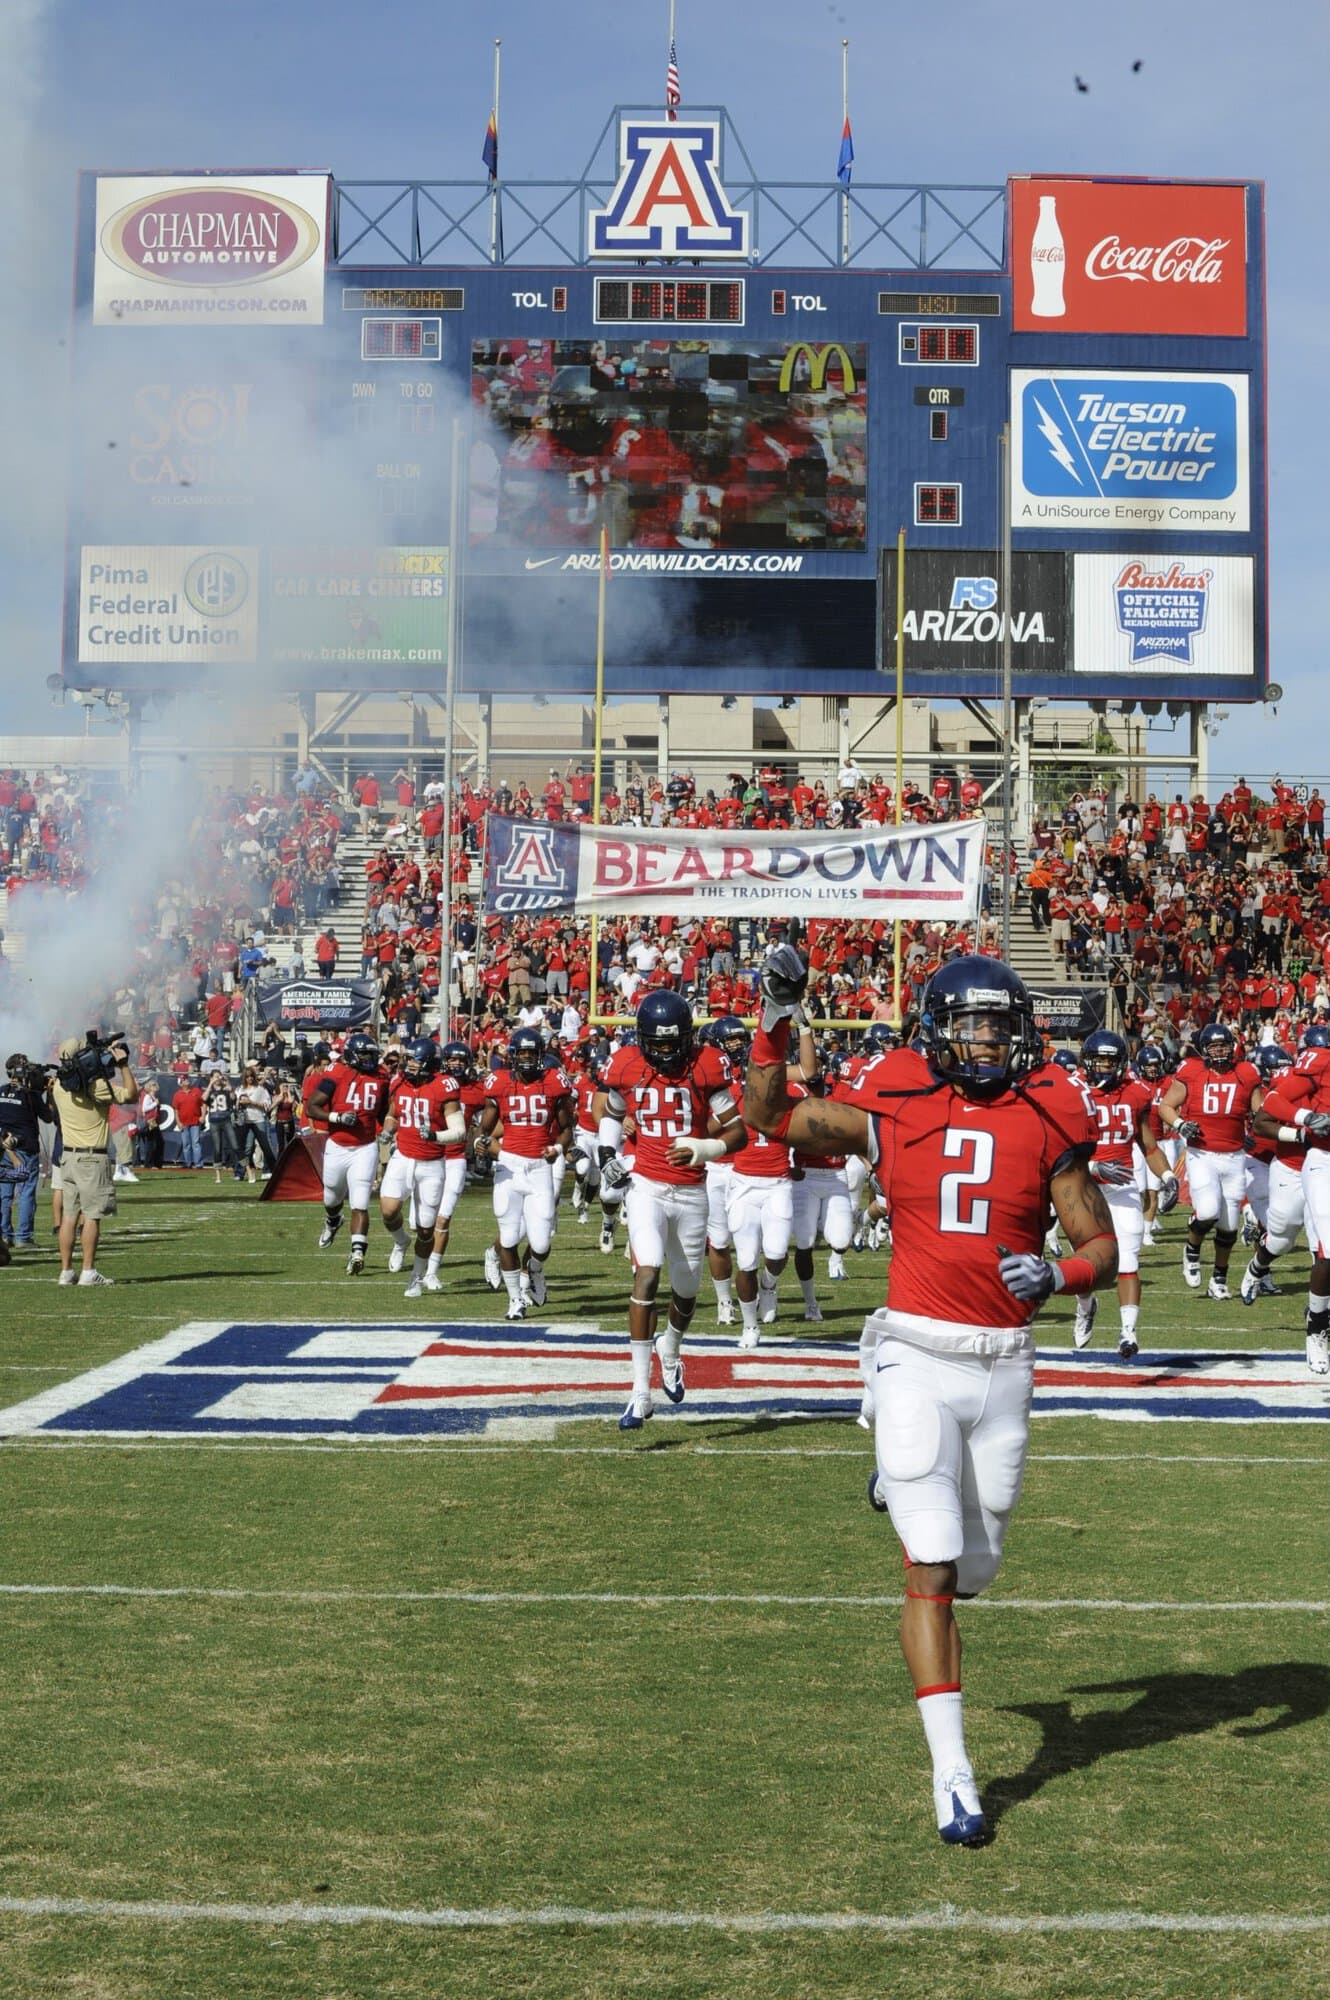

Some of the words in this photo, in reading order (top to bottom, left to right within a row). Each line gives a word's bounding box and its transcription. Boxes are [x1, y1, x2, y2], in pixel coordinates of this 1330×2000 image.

[138, 212, 281, 248] CHAPMAN
[142, 249, 277, 264] AUTOMOTIVE
[1085, 235, 1231, 283] Coca-Cola
[109, 298, 307, 313] CHAPMANTUCSON.COM
[364, 290, 444, 309] ARIZONA
[512, 292, 548, 308] TOL
[791, 295, 826, 311] TOL
[918, 295, 957, 315] WSU
[400, 383, 413, 397] TO
[417, 383, 433, 397] GO
[929, 388, 950, 404] QTR
[1078, 393, 1187, 424] Tucson
[1088, 424, 1216, 453] Electric
[1101, 453, 1216, 481] Power
[920, 488, 957, 519] 25
[1022, 505, 1033, 517] A
[1037, 505, 1111, 518] UniSource
[1115, 506, 1165, 522] Energy
[1169, 507, 1236, 524] Company
[89, 564, 148, 585] Pima
[1117, 564, 1210, 589] Bashas'
[368, 578, 443, 597] CENTERS
[950, 576, 998, 611] FS
[88, 595, 177, 615] Federal
[1123, 595, 1200, 606] OFFICIAL
[1123, 607, 1199, 619] TAILGATE
[894, 610, 1046, 643] ARIZONA
[1124, 619, 1199, 628] HEADQUARTERS
[88, 625, 161, 645] Credit
[168, 625, 239, 646] Union
[1136, 636, 1186, 647] ARIZONA
[272, 646, 442, 661] www.brakemax.com
[1294, 787, 1307, 801] 29
[700, 887, 725, 898] THE
[732, 887, 815, 899] TRADITION
[818, 887, 858, 899] LIVES
[346, 1082, 378, 1110] 46
[1203, 1083, 1237, 1114] 67
[399, 1096, 431, 1128] 38
[509, 1095, 549, 1126] 26
[634, 1087, 693, 1137] 23
[1096, 1104, 1134, 1145] 23
[940, 1128, 995, 1235] 2
